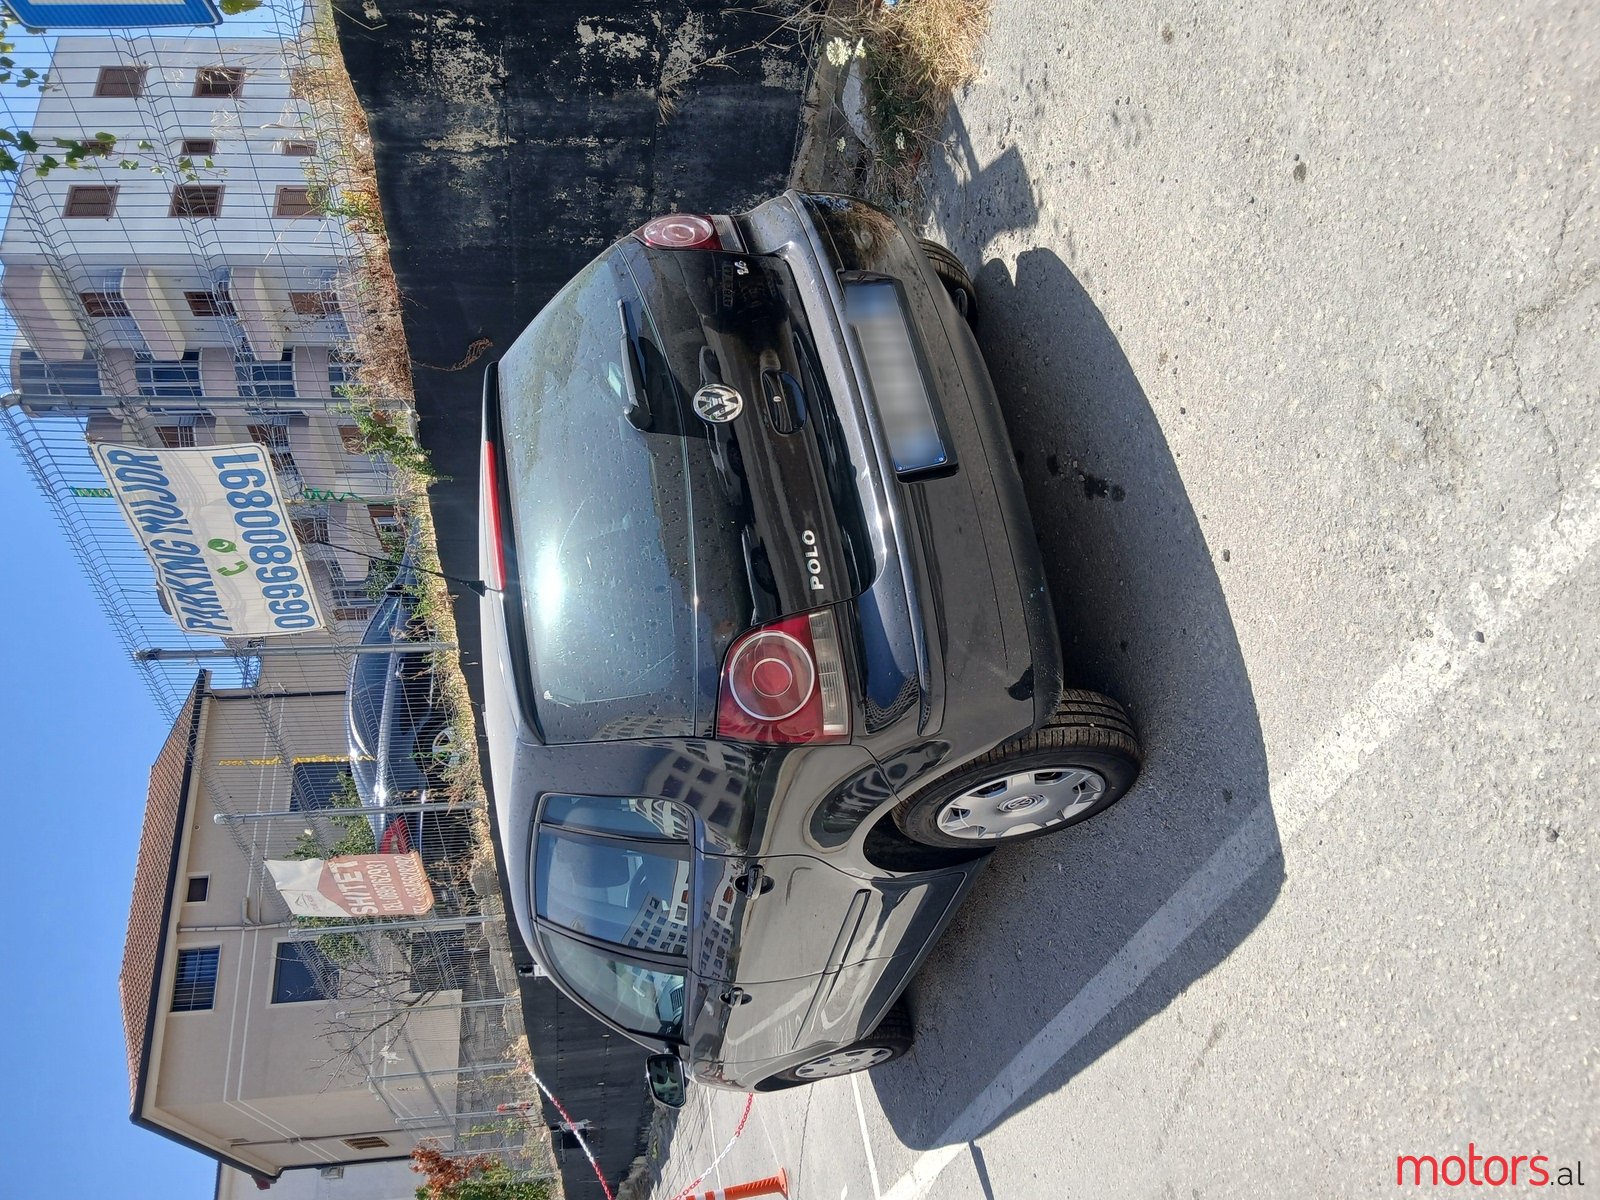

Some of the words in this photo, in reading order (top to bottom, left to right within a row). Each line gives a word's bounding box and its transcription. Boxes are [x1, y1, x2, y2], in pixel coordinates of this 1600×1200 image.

[106, 449, 193, 536] MUJOR
[211, 452, 316, 629] 0696800891
[801, 529, 825, 591] POLO
[150, 539, 233, 632] PARKING
[328, 860, 379, 915] SHITET
